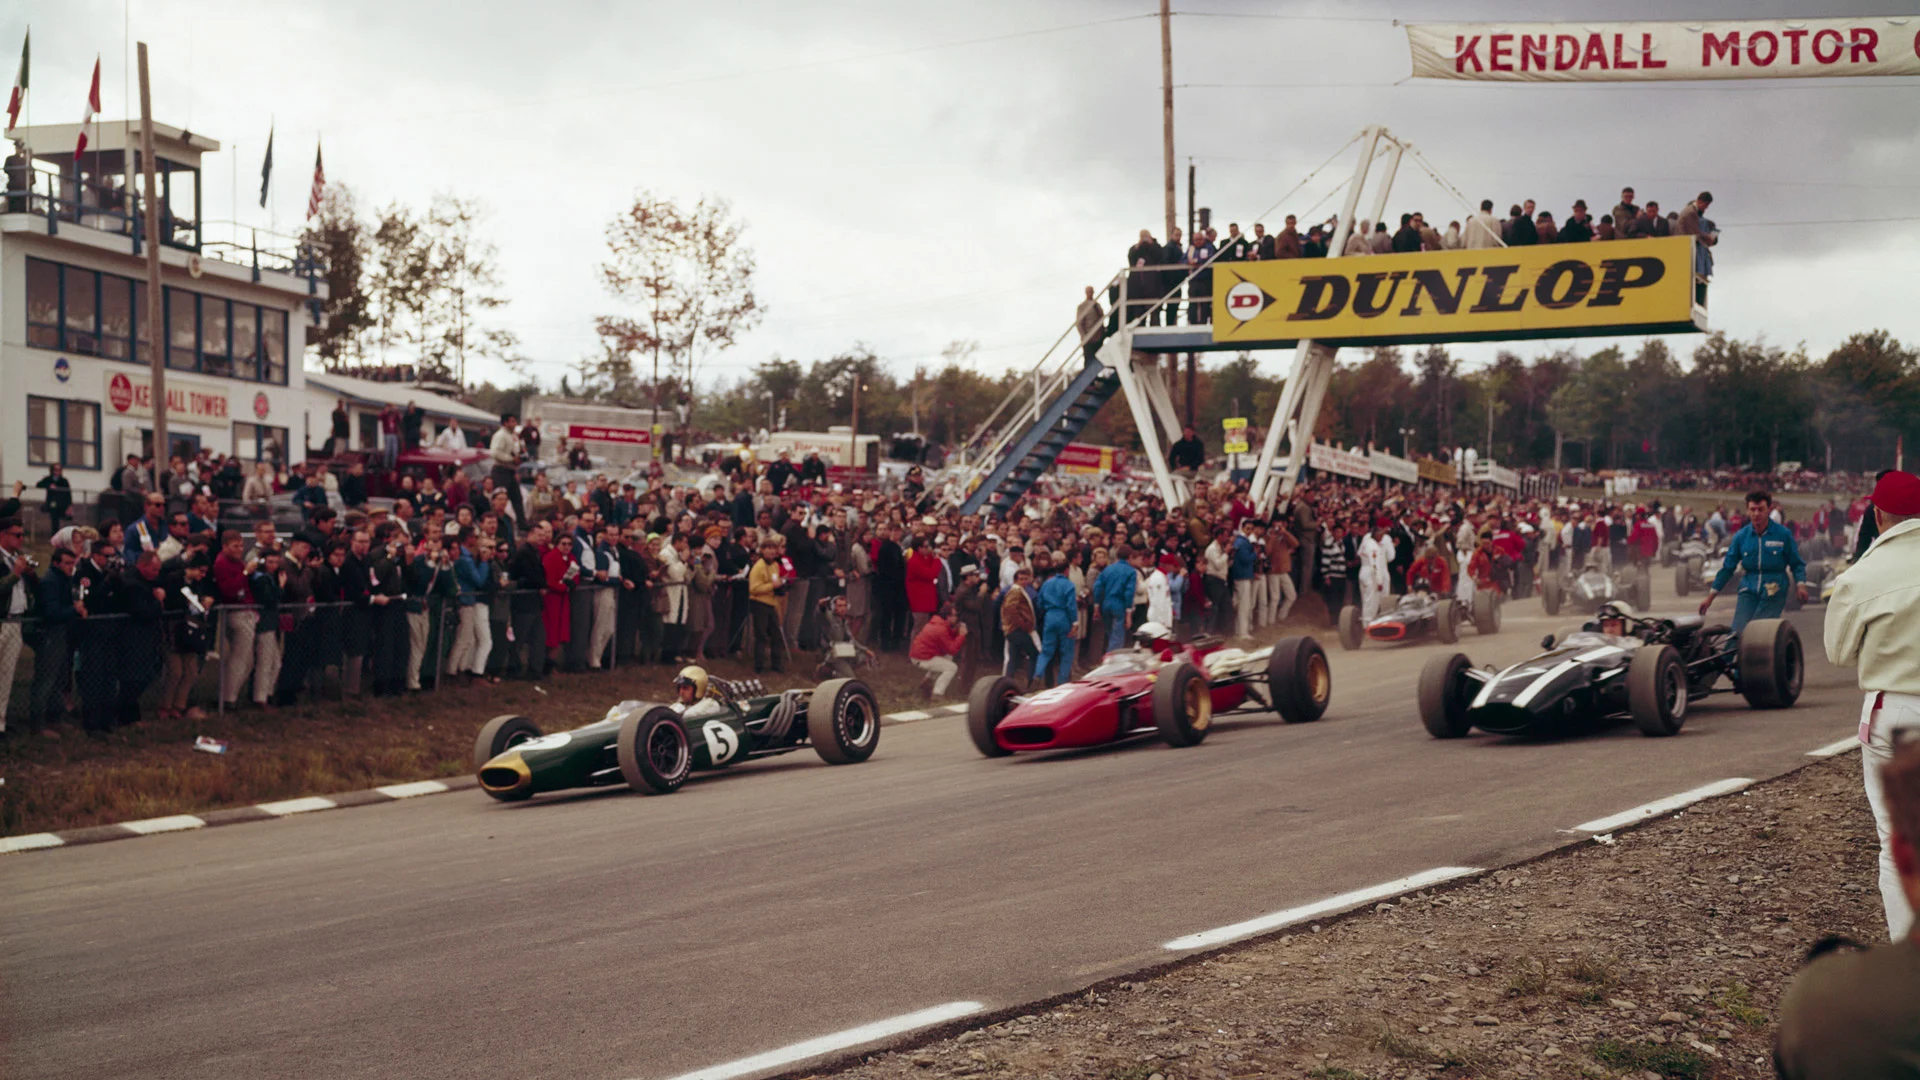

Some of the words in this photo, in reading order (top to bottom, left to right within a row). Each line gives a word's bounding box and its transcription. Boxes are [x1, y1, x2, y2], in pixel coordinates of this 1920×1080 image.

[1455, 33, 1667, 73] KENDALL
[1701, 27, 1880, 67] MOTOR
[1231, 294, 1260, 308] D
[1286, 256, 1666, 322] DUNLOP
[134, 384, 186, 413] KEALL
[189, 391, 229, 418] TOWER
[710, 726, 730, 760] 5
